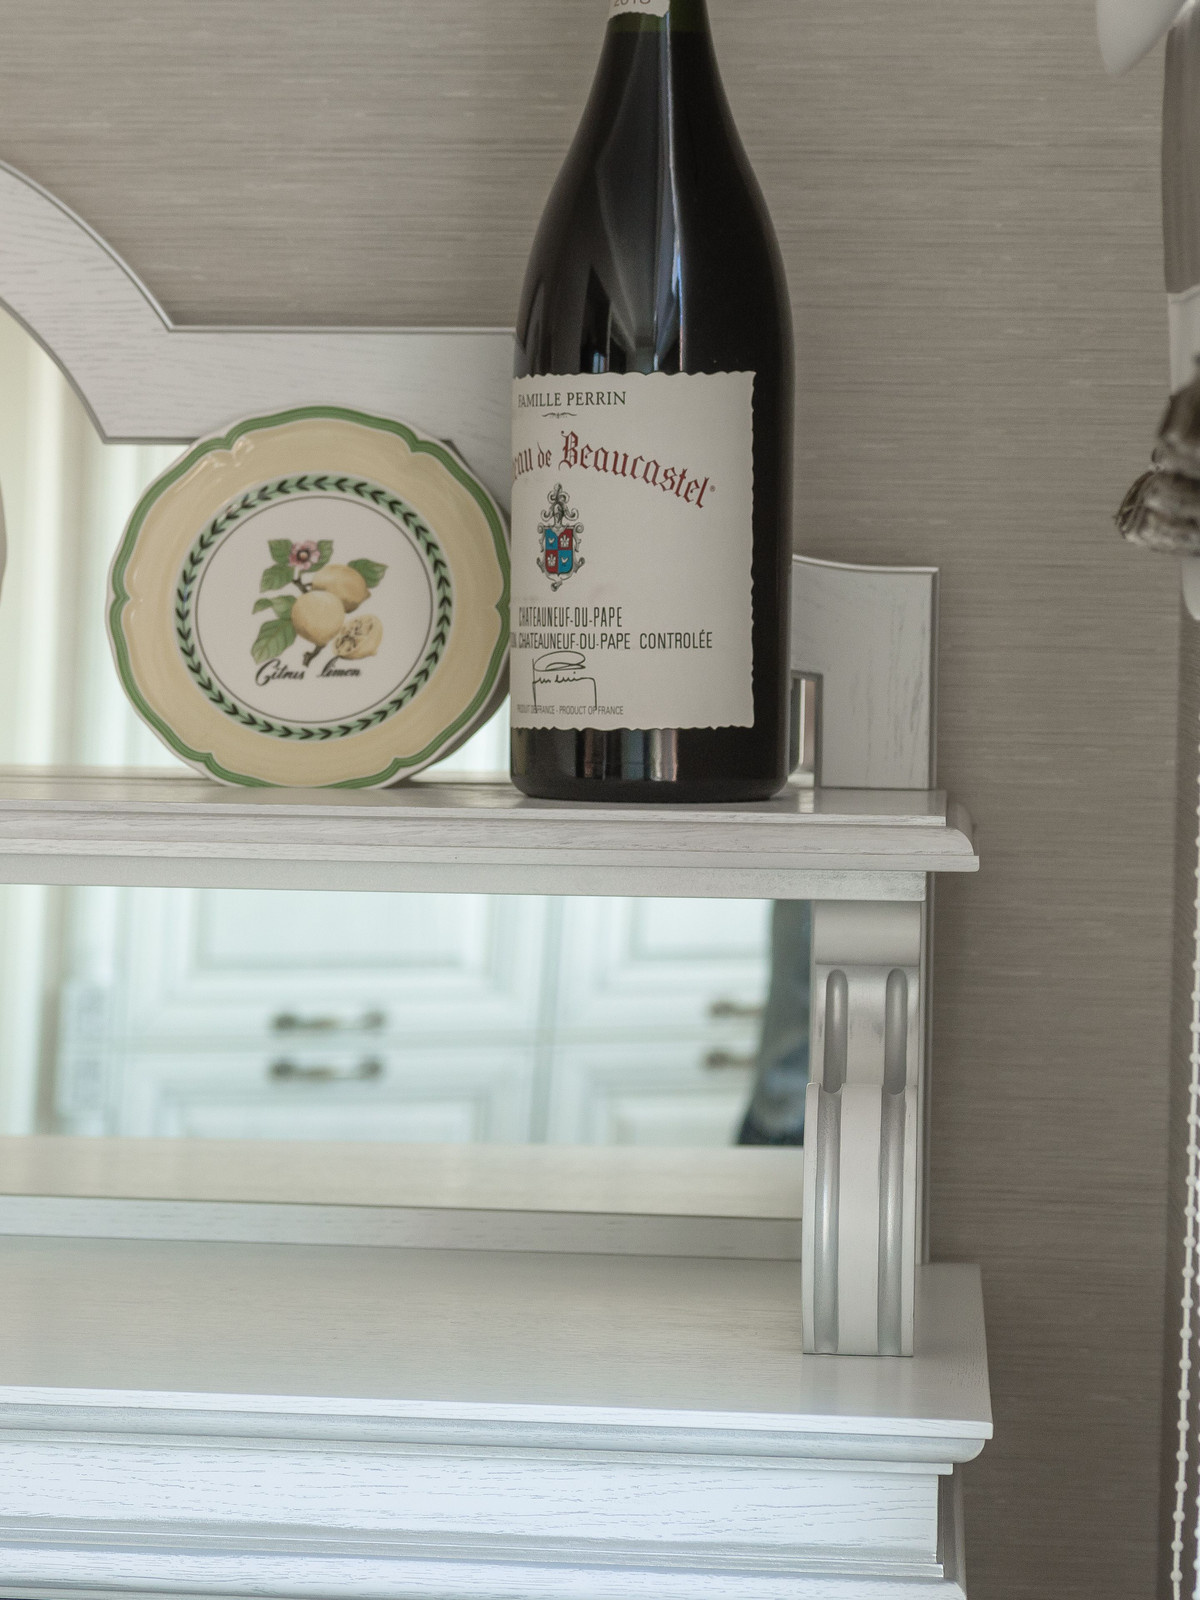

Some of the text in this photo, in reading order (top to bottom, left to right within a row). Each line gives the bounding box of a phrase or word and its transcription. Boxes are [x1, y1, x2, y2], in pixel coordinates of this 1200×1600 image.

[518, 391, 626, 408] FAMILLE PERRIN
[536, 441, 552, 469] de
[558, 430, 709, 509] Beaucastel
[519, 606, 623, 628] CHATEAUNEUF-DU-PAPE
[519, 632, 631, 650] CHATEAUNEUF-DU-PAPE
[639, 629, 713, 650] CONTROLÉE
[559, 705, 586, 715] PRODUCT
[598, 706, 624, 716] FRANCE
